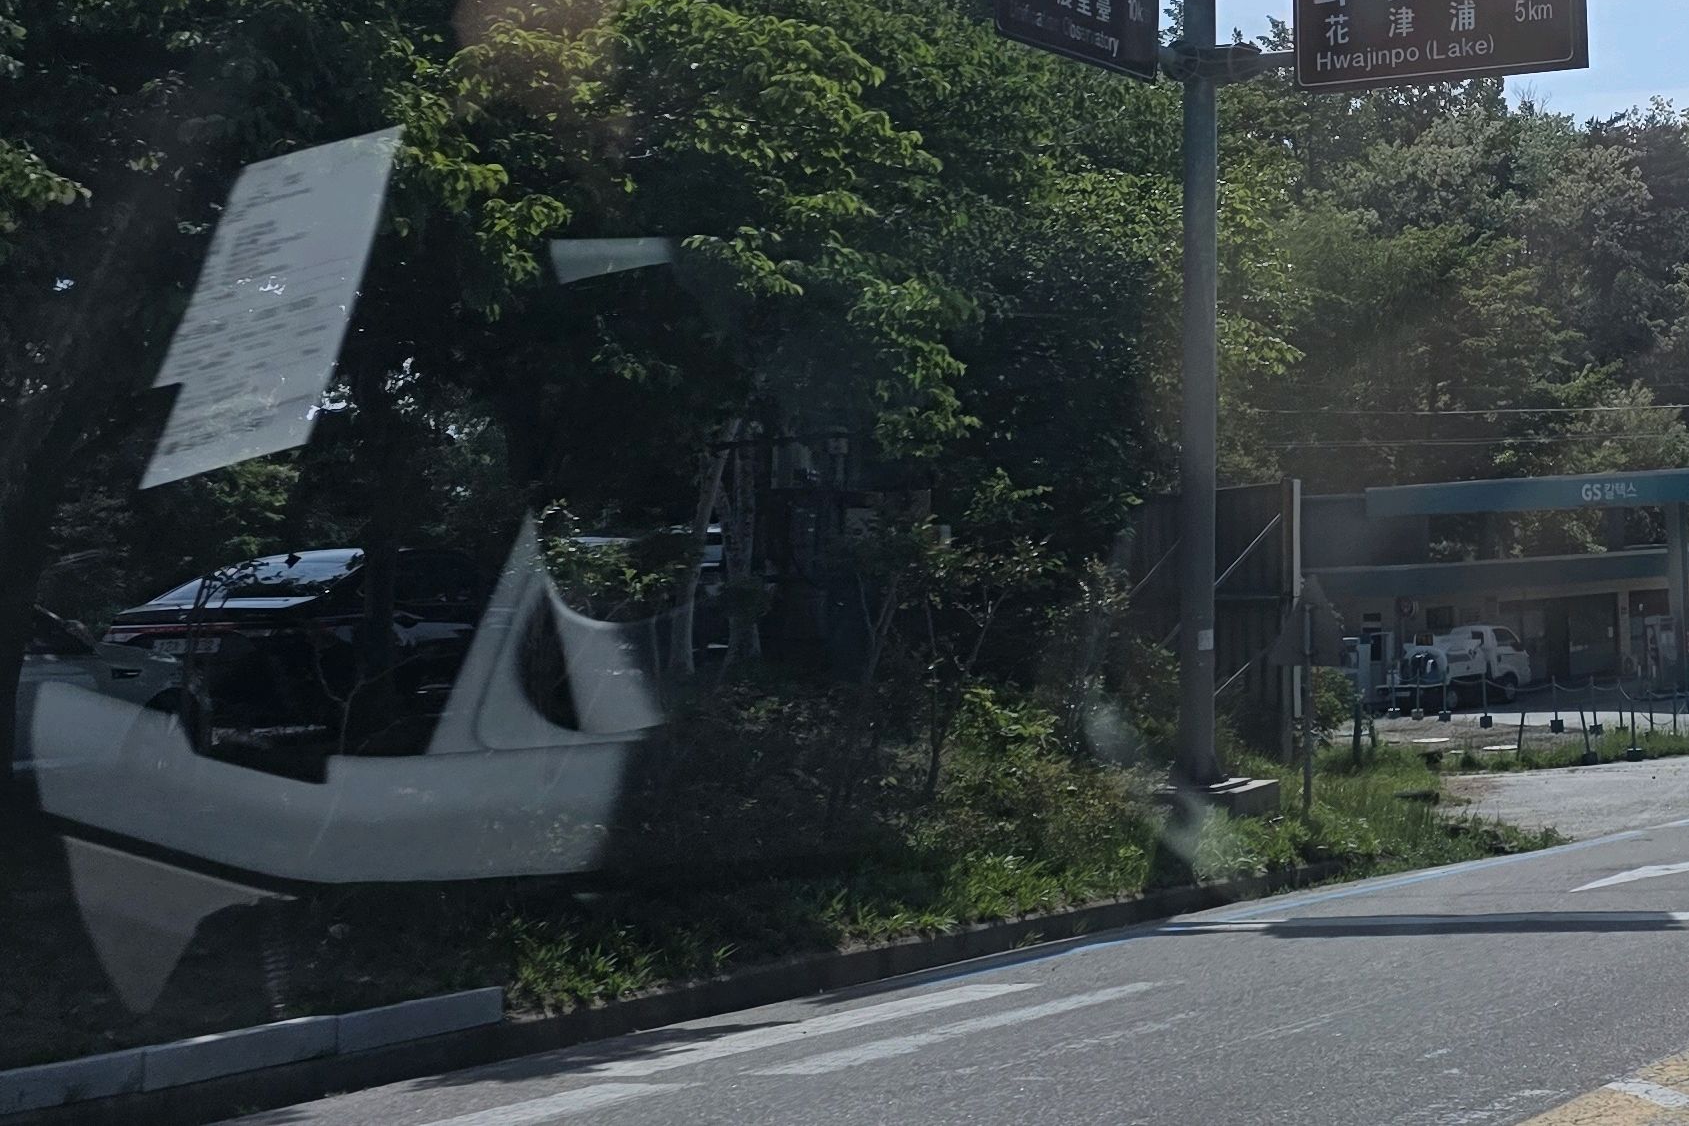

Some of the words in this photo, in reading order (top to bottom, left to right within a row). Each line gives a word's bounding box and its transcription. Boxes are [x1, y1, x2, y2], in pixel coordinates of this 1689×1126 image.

[1514, 0, 1553, 22] 5km
[1317, 46, 1419, 71] Hwajinpo
[1426, 34, 1494, 60] (Lake)
